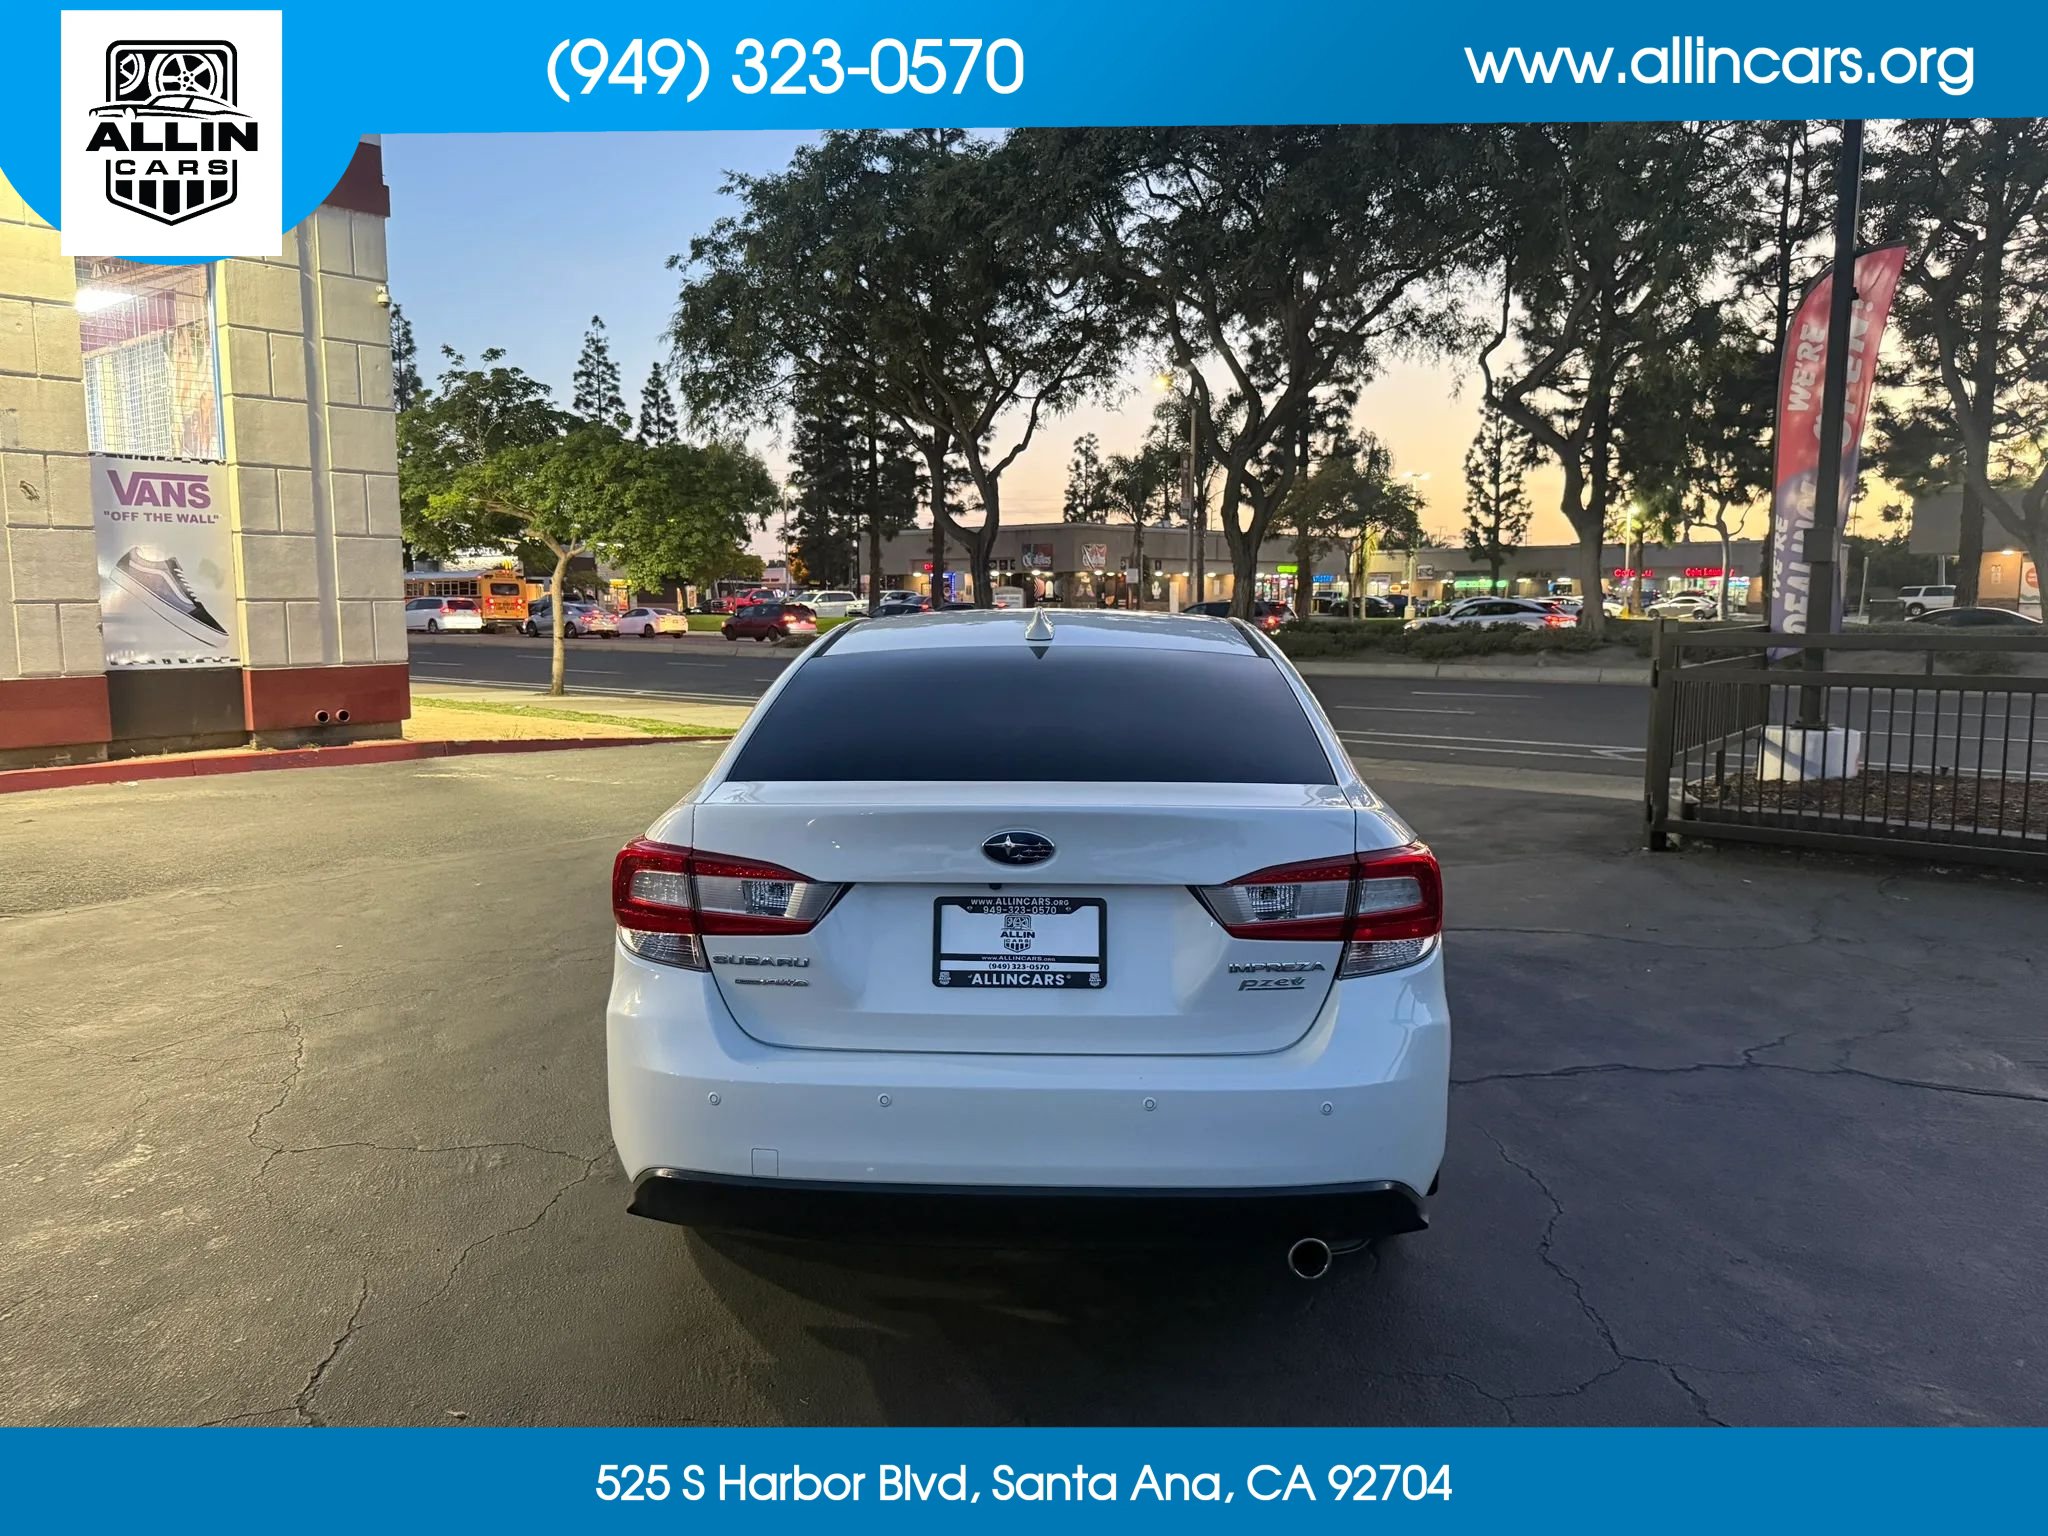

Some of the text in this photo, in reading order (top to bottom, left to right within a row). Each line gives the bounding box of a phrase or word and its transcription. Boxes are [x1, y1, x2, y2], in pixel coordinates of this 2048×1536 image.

[1787, 324, 1826, 411] WE'RE
[107, 469, 211, 509] VANS
[143, 512, 173, 523] THE
[983, 905, 1057, 914] 949-323-0570
[1000, 931, 1036, 939] ALLIN
[712, 954, 810, 968] SUBARU
[988, 963, 1050, 971] (949) 323-0570
[1228, 961, 1326, 974] IMPREZA
